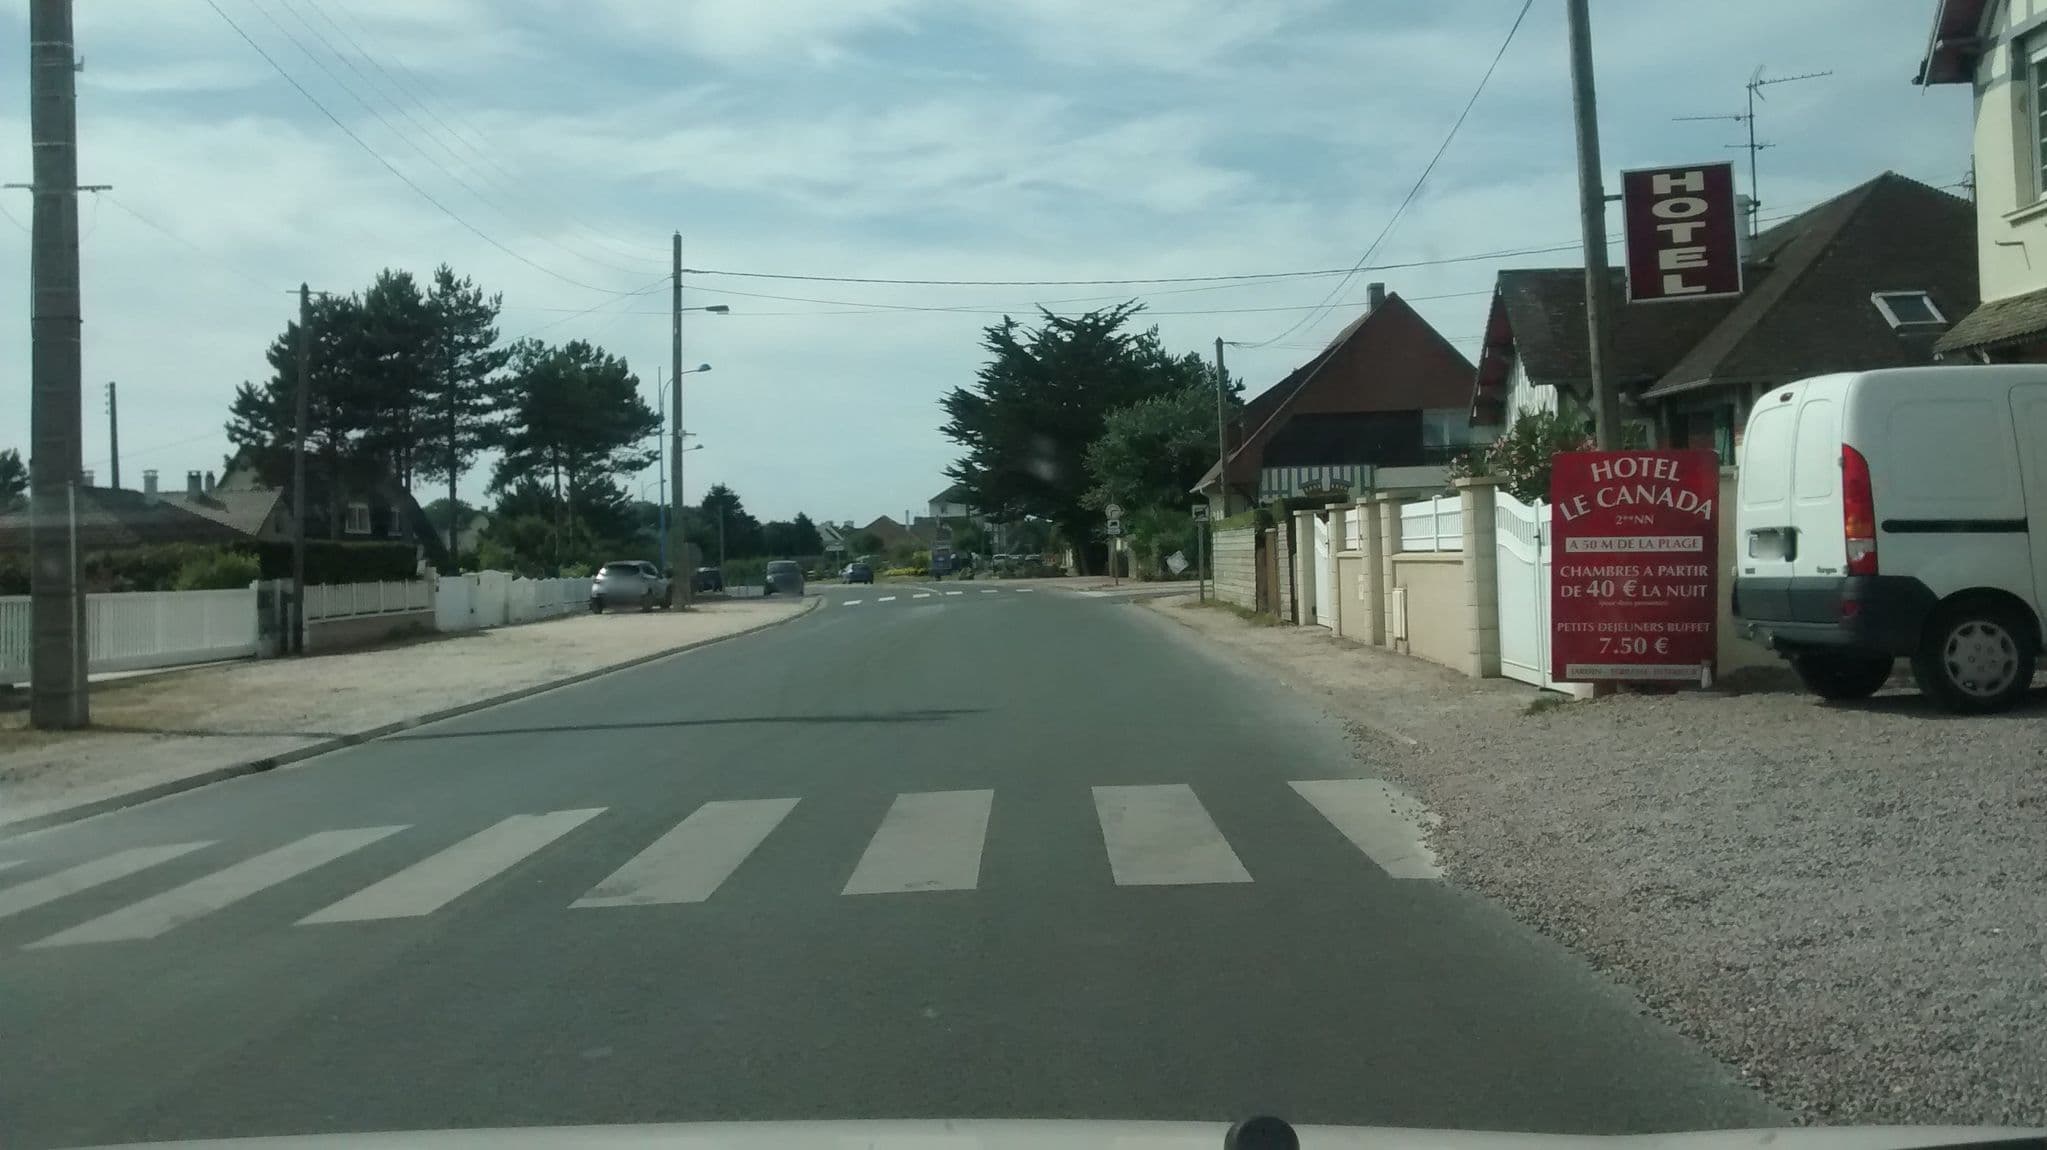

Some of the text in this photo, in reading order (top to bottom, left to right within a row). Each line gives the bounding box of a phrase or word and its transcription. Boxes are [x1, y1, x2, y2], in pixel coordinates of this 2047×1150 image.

[1652, 171, 1708, 294] HOTEL
[1591, 457, 1680, 482] HOTEL
[1560, 484, 1713, 521] LE CANADA
[1569, 538, 1698, 549] A 50 M DE LA PLAGE
[1560, 565, 1708, 577] CHAMBRES A PARTIR
[1561, 579, 1708, 597] DE 40 € LA NUIT
[1557, 622, 1711, 633] PETITS DEJEUNERS BUFFET
[1600, 637, 1669, 654] 7.50 €
